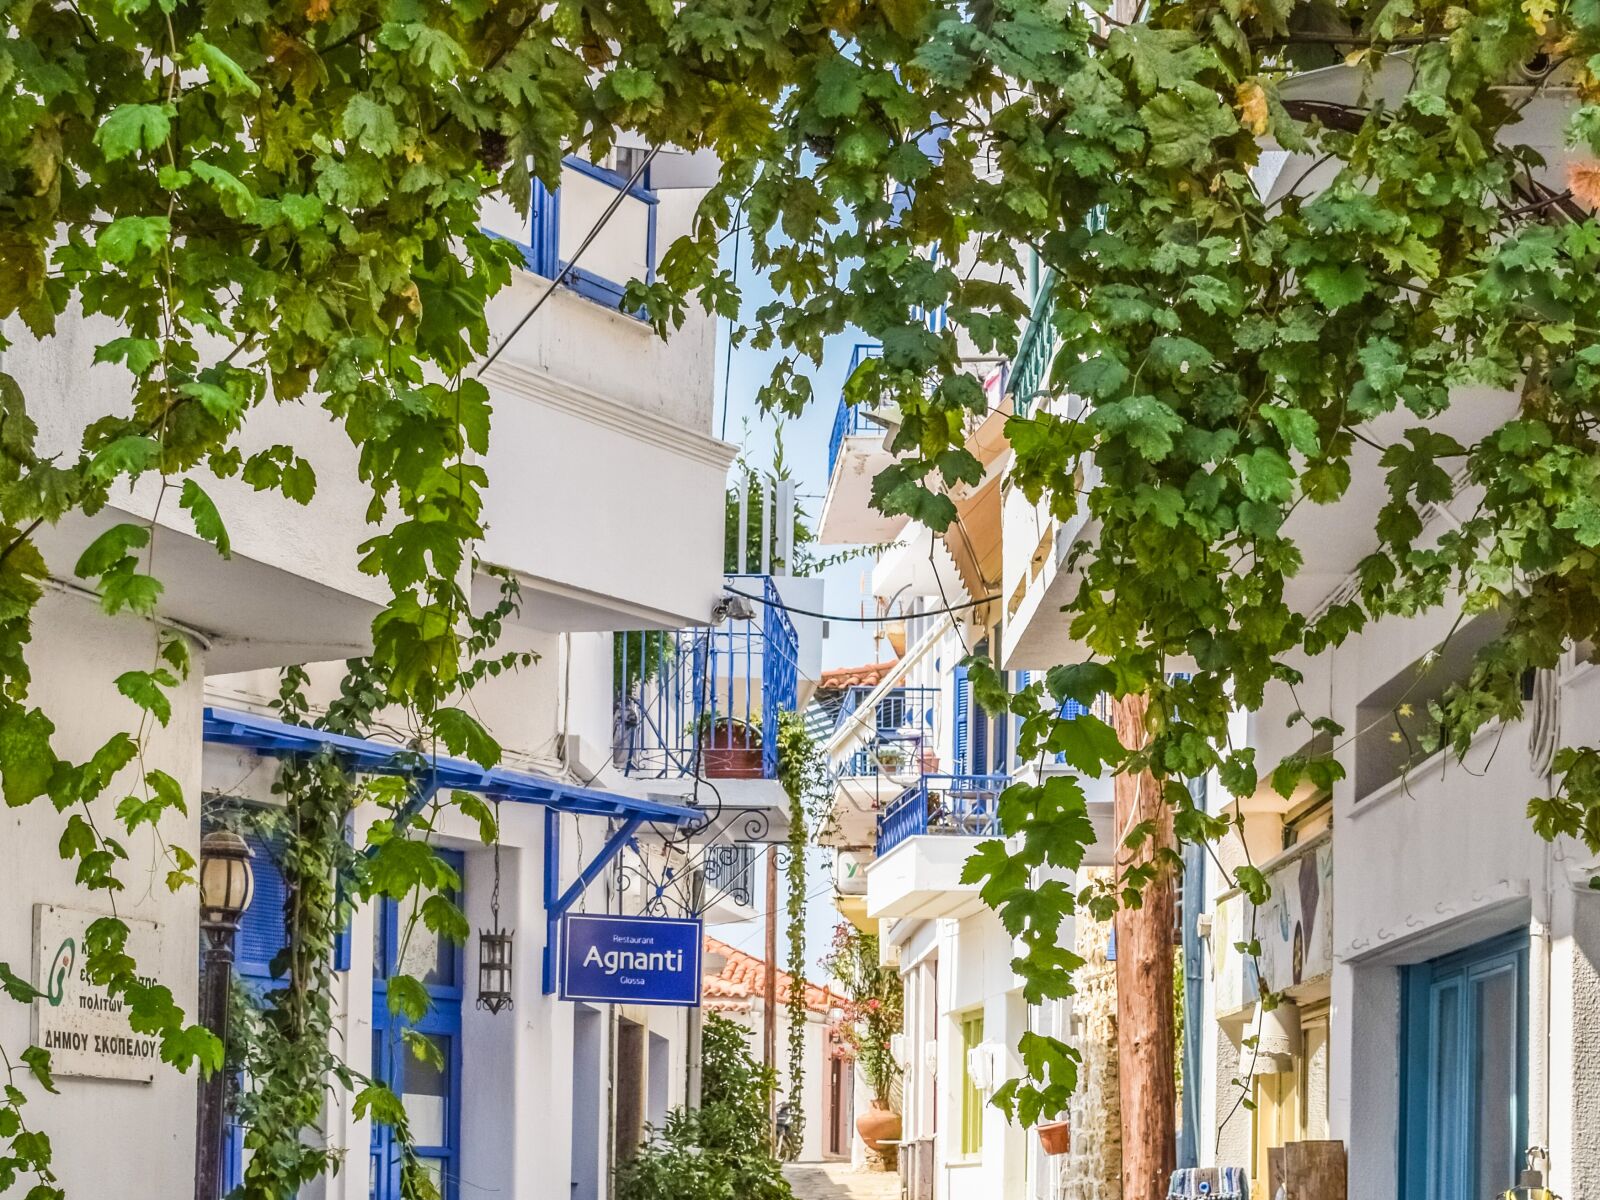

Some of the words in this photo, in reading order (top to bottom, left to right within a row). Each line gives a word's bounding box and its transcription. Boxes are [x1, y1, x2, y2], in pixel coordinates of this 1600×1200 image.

[613, 935, 654, 945] Restaurant
[583, 945, 683, 975] Agnanti
[620, 976, 646, 985] Glossa
[45, 1030, 89, 1051] ΔΗΜΟΥ
[94, 1034, 157, 1058] ΣΚΟΠΕΛΟΥ
